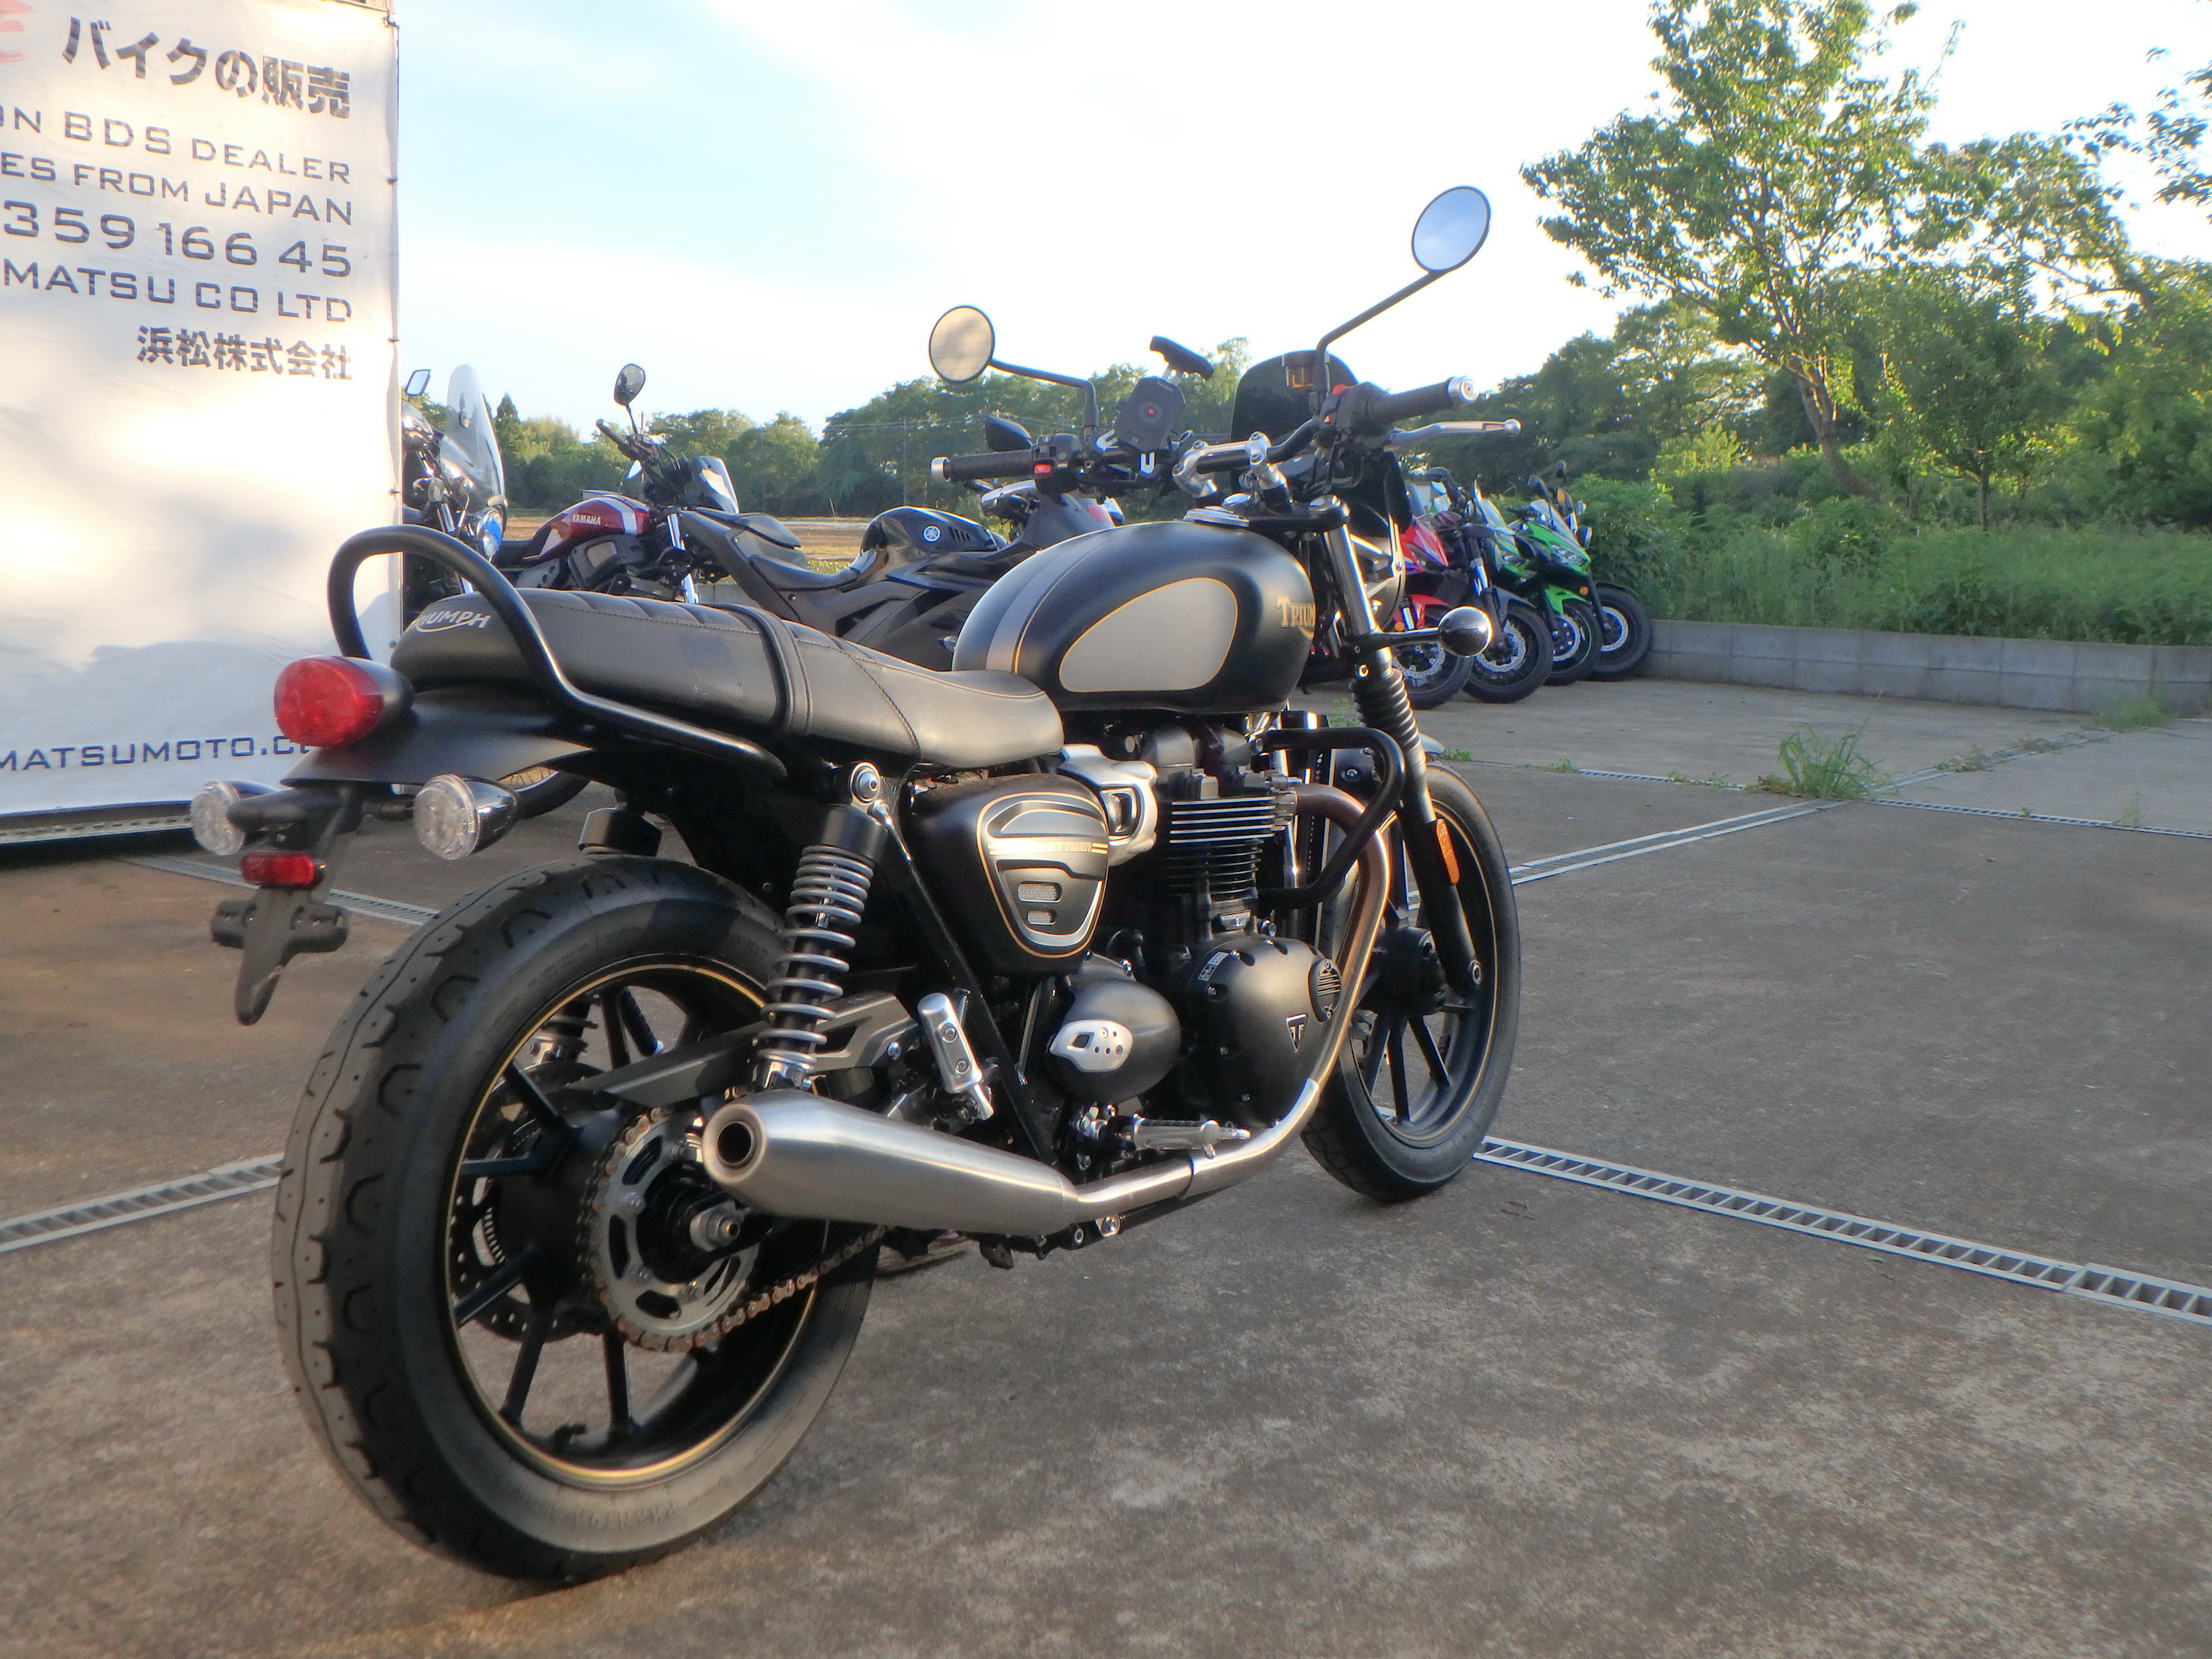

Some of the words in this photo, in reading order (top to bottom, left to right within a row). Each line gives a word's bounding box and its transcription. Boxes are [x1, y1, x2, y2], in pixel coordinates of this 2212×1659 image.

[62, 16, 350, 120] バイクの販売
[0, 104, 41, 133] N
[65, 111, 171, 155] BDS
[192, 138, 350, 184] DEALER
[1, 152, 56, 182] ES
[73, 164, 189, 202] FROM
[205, 182, 352, 226] JAPAN
[3, 200, 135, 250] 359
[158, 222, 258, 265] 166
[278, 240, 352, 277] 45
[3, 258, 175, 304] MATSU
[195, 281, 259, 314] CO
[277, 291, 352, 322] LTD
[137, 325, 352, 380] 浜松株式会社
[573, 514, 601, 525] YAMAHA
